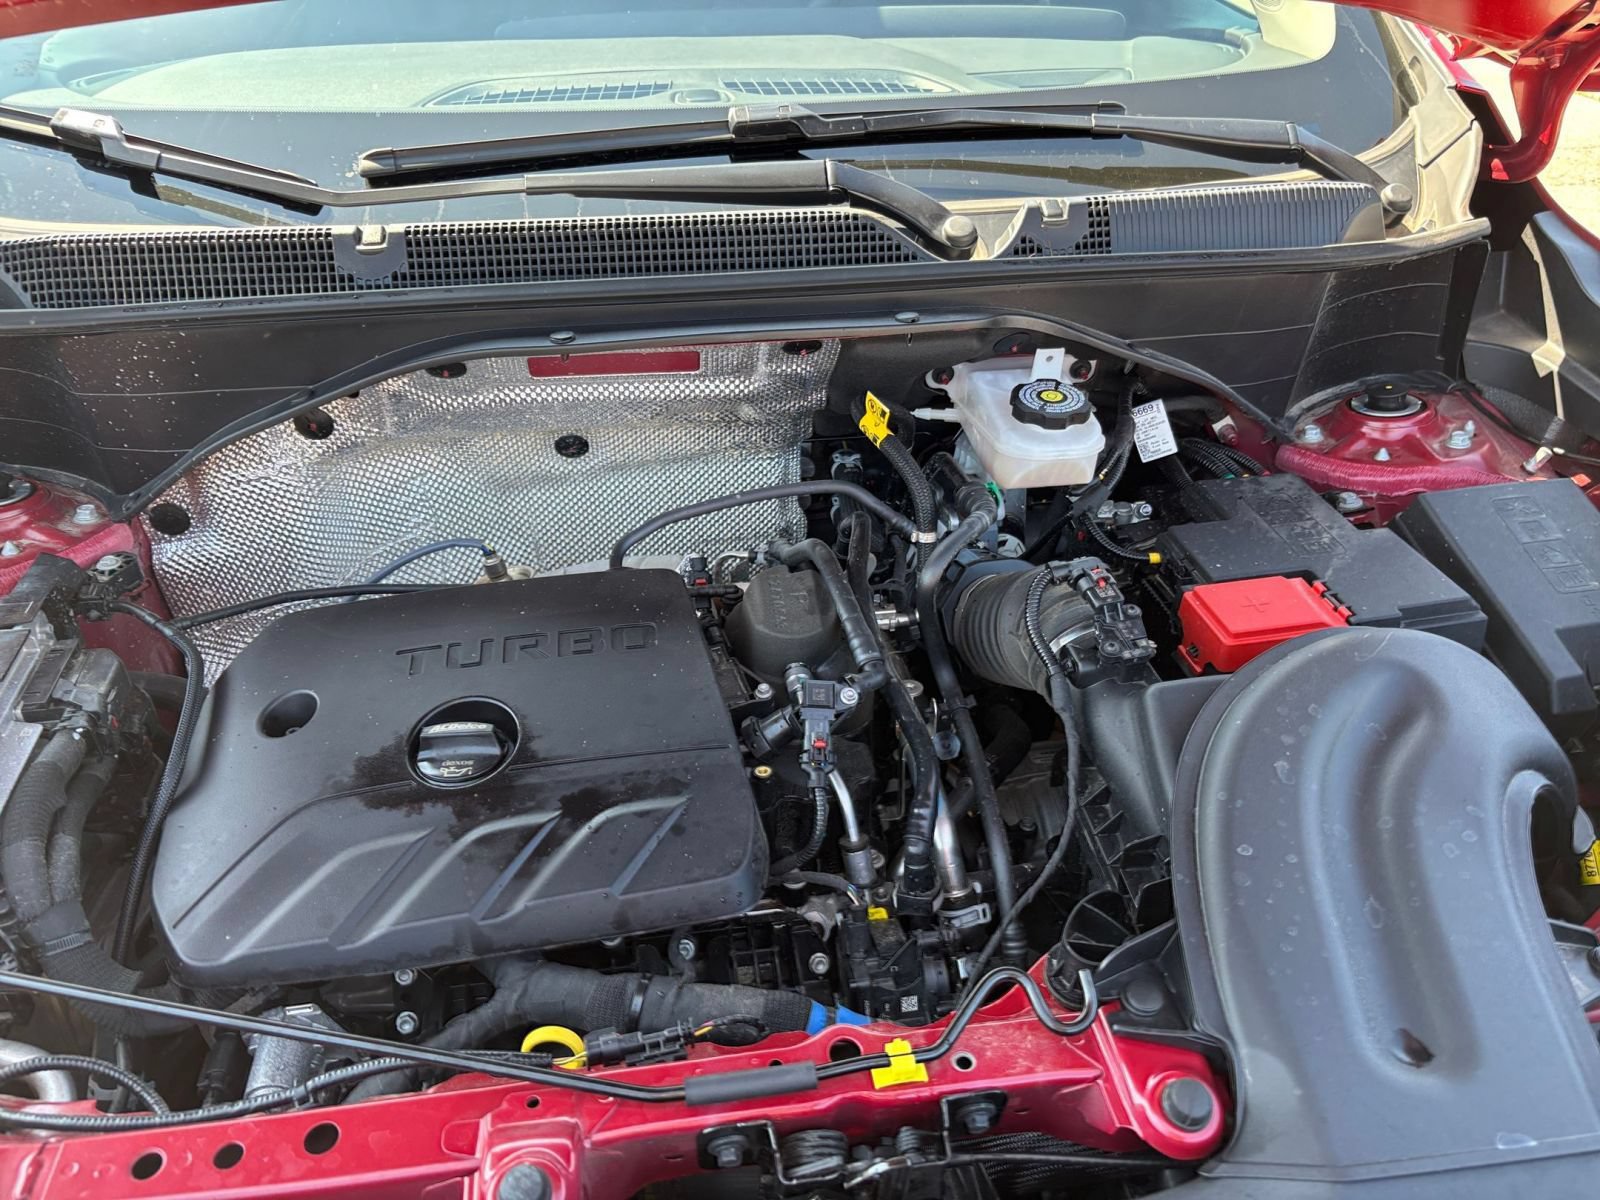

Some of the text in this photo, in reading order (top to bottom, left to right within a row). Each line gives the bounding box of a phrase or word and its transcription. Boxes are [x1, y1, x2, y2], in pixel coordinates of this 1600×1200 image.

[396, 622, 657, 675] TURBO
[428, 723, 487, 734] ACDelco
[441, 759, 475, 767] dexos
